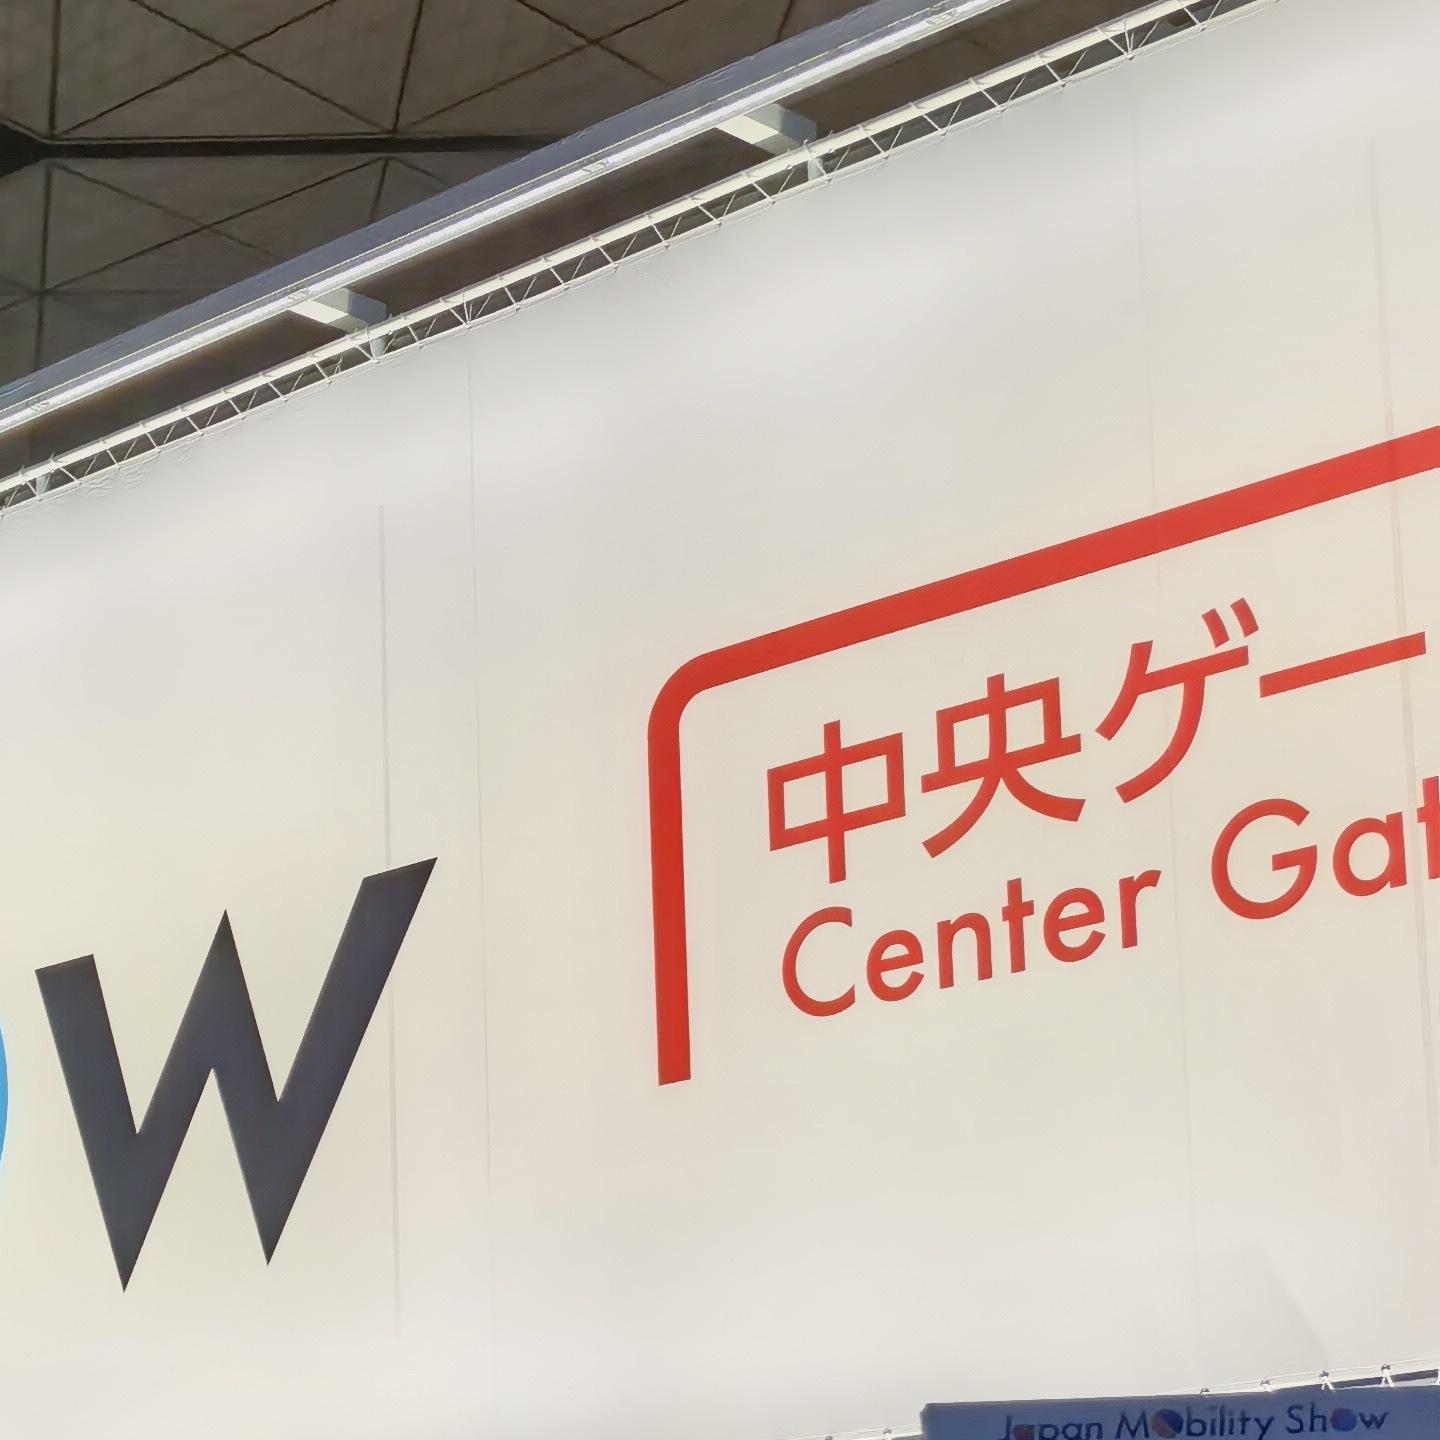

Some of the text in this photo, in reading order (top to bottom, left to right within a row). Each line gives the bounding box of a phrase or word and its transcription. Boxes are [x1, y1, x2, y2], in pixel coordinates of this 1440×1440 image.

[767, 597, 1426, 884] 中央ゲー
[782, 870, 1162, 1017] Center
[1285, 1402, 1388, 1435] Show
